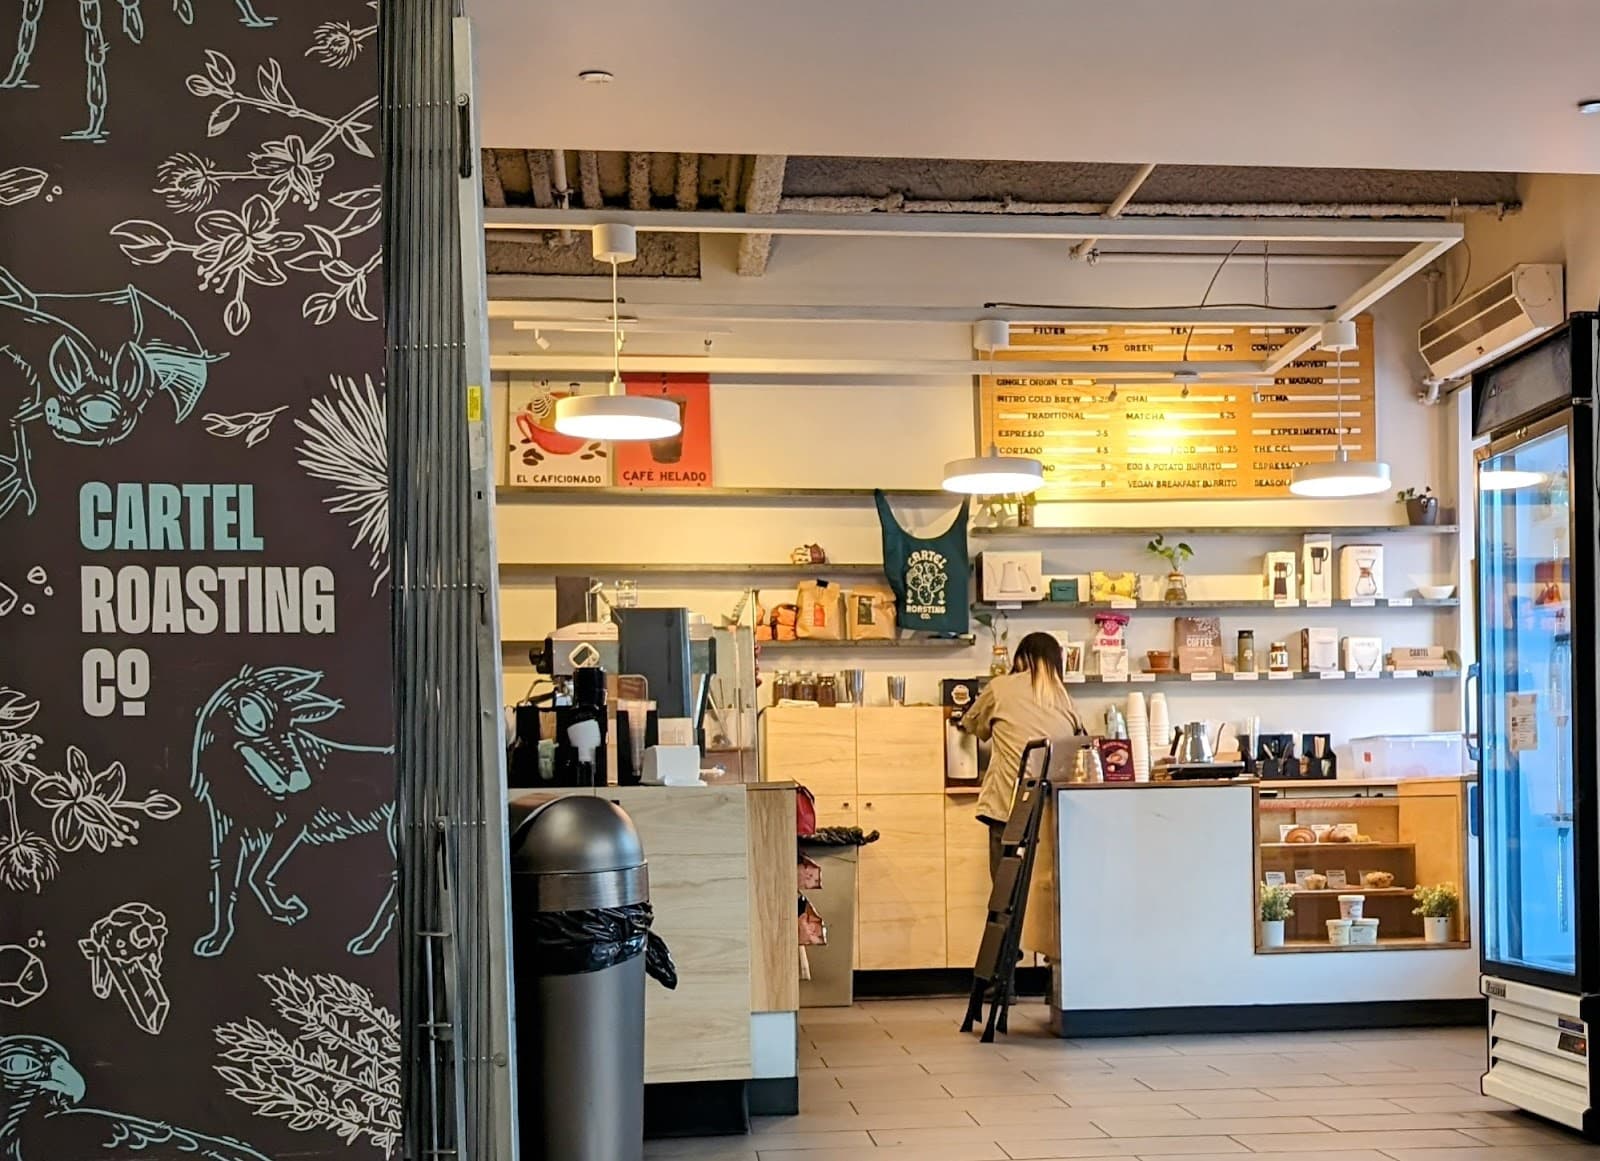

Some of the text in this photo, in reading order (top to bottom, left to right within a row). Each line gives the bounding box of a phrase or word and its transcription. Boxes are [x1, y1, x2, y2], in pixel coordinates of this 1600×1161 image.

[1033, 327, 1066, 335] FILTER
[1170, 327, 1188, 335] TEA
[1124, 344, 1154, 352] GREEN
[1031, 395, 1052, 403] COLD
[1054, 395, 1081, 403] BREW
[1126, 395, 1148, 403] CHAI
[1026, 412, 1086, 420] TRADITIONAL
[1126, 412, 1165, 420] MATCHA
[998, 429, 1045, 438] ESPRESSO
[1270, 427, 1337, 436] EXPERIMENTAL
[999, 446, 1043, 455] CORTADO
[1253, 445, 1272, 453] THE
[1153, 463, 1184, 471] POTATO
[1186, 462, 1222, 470] BURRITO
[516, 475, 601, 484] EL CAFICIONADO
[623, 469, 707, 482] CAFÉ HELADO
[1128, 479, 1237, 488] VEGAN BREAKFAST BURRITO
[79, 481, 264, 551] CARTEL
[908, 550, 947, 569] CARTEL
[80, 565, 336, 634] ROASTING
[906, 605, 946, 614] ROASTING
